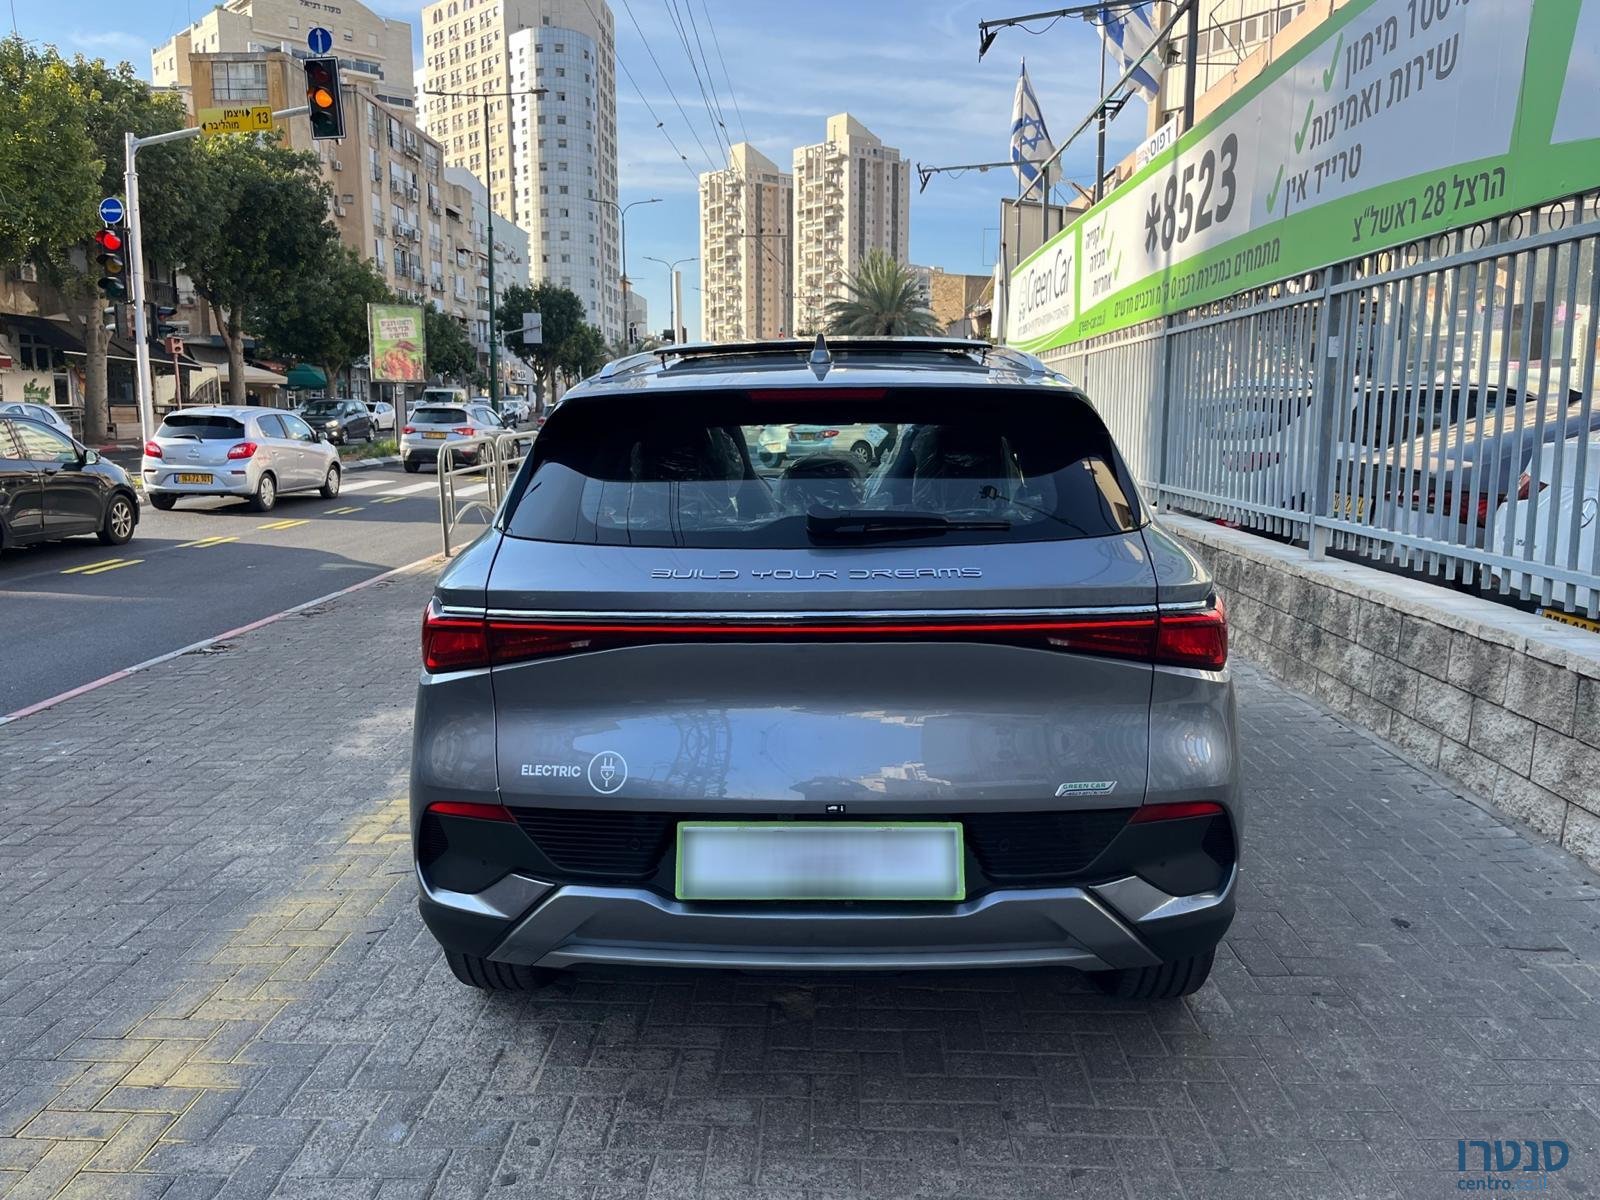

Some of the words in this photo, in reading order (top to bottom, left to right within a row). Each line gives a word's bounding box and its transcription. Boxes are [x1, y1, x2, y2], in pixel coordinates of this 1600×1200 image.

[1344, 16, 1398, 90] מימון
[1386, 32, 1459, 108] שירות
[207, 119, 240, 130] מוהליבר
[223, 109, 245, 120] ויצמן
[256, 112, 269, 124] 13
[1309, 78, 1382, 150] ואמינות
[1150, 126, 1171, 156] דפוס
[1314, 143, 1362, 194] טרייד
[1453, 166, 1505, 210] הרצל
[1284, 169, 1309, 218] אין
[1421, 181, 1447, 221] 28
[1054, 249, 1072, 298] Car
[1089, 249, 1106, 273] מכירה
[1198, 259, 1232, 291] במכירת
[1233, 237, 1281, 276] מתמחים
[651, 568, 739, 580] BUILD
[751, 568, 839, 580] YOUR
[848, 566, 983, 579] DREAMS
[521, 764, 581, 777] ELECTRIC
